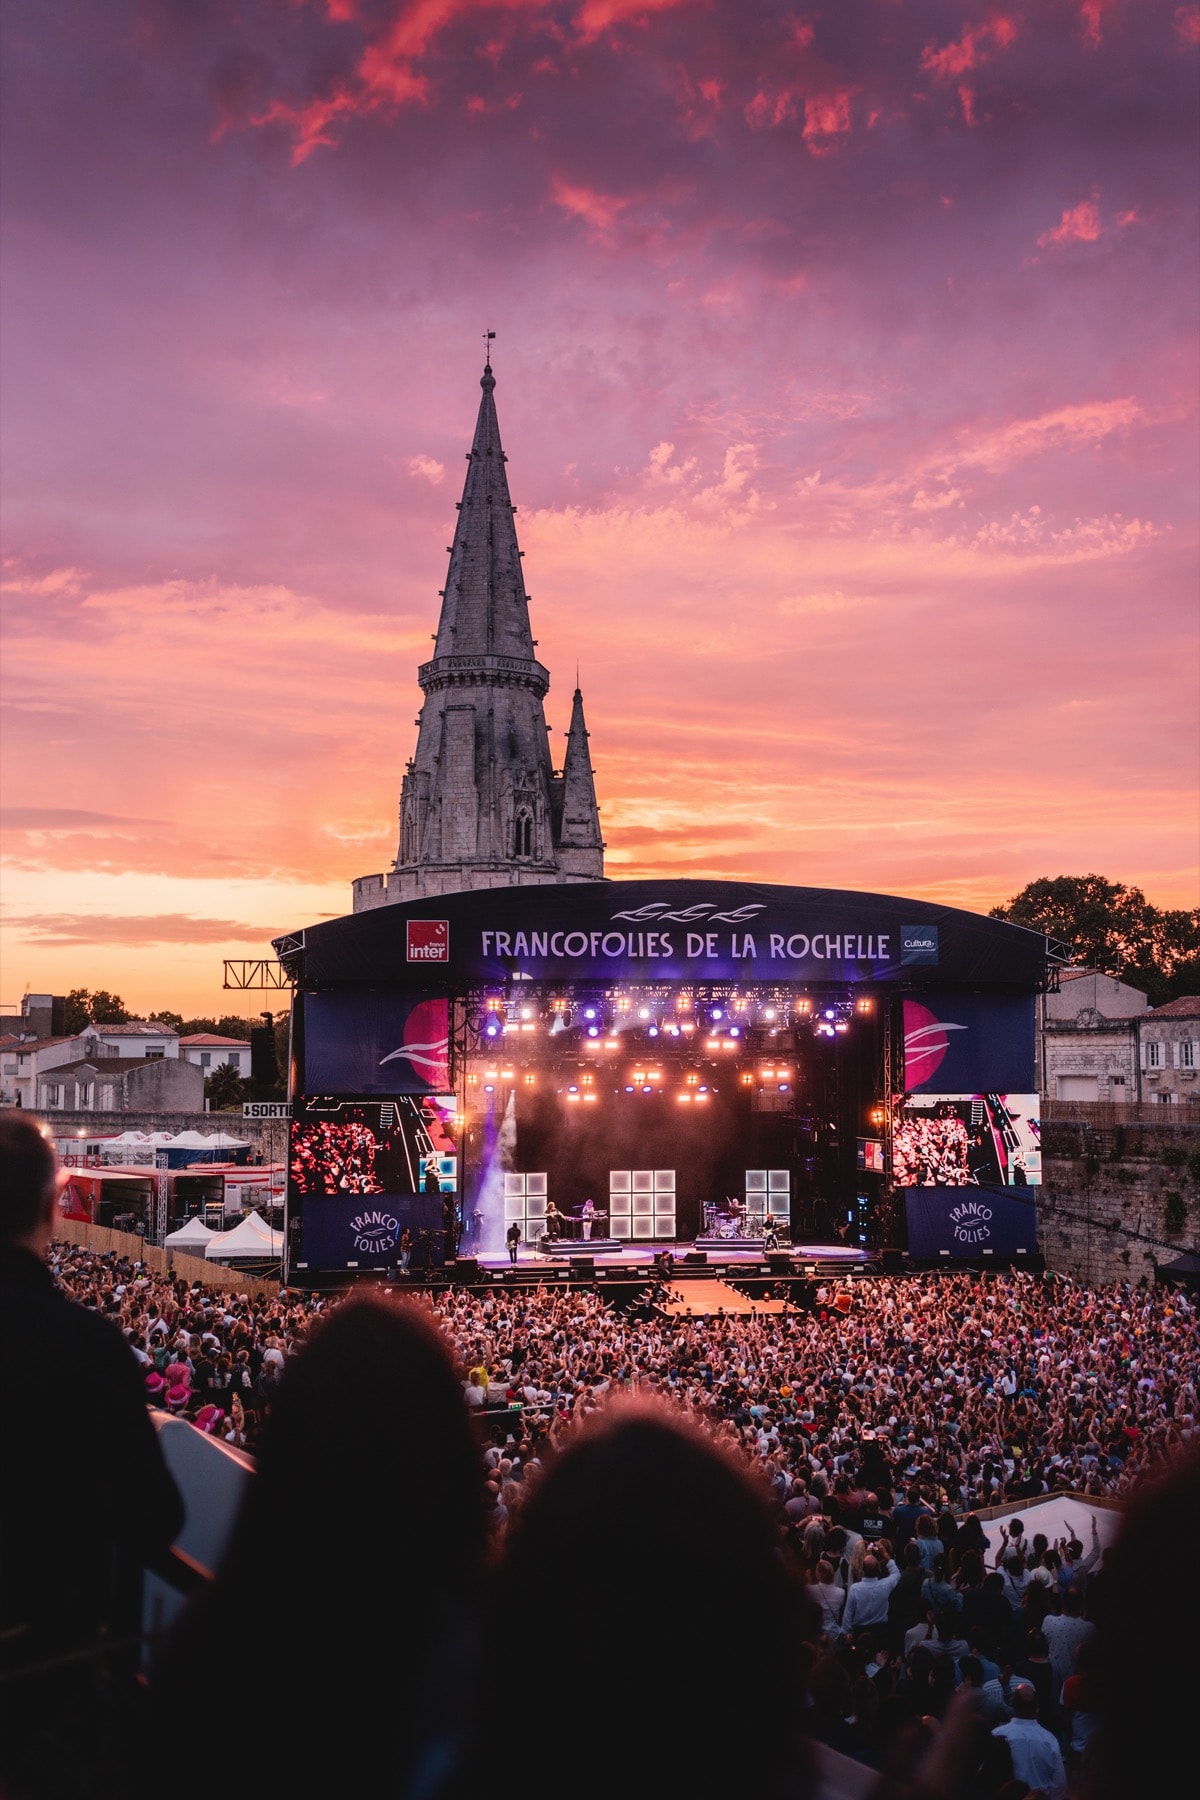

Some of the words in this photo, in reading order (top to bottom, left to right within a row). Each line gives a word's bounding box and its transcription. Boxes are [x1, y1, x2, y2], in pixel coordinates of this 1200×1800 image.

[410, 944, 446, 958] inter
[481, 931, 674, 957] FRANCOFOLIES
[686, 933, 719, 958] DE
[731, 933, 757, 958] LA
[769, 934, 890, 959] ROCHELLE
[349, 1211, 398, 1232] FRANCO
[949, 1202, 993, 1222] FRANCO
[954, 1225, 991, 1243] FOLIES
[353, 1235, 395, 1253] FOLIES
